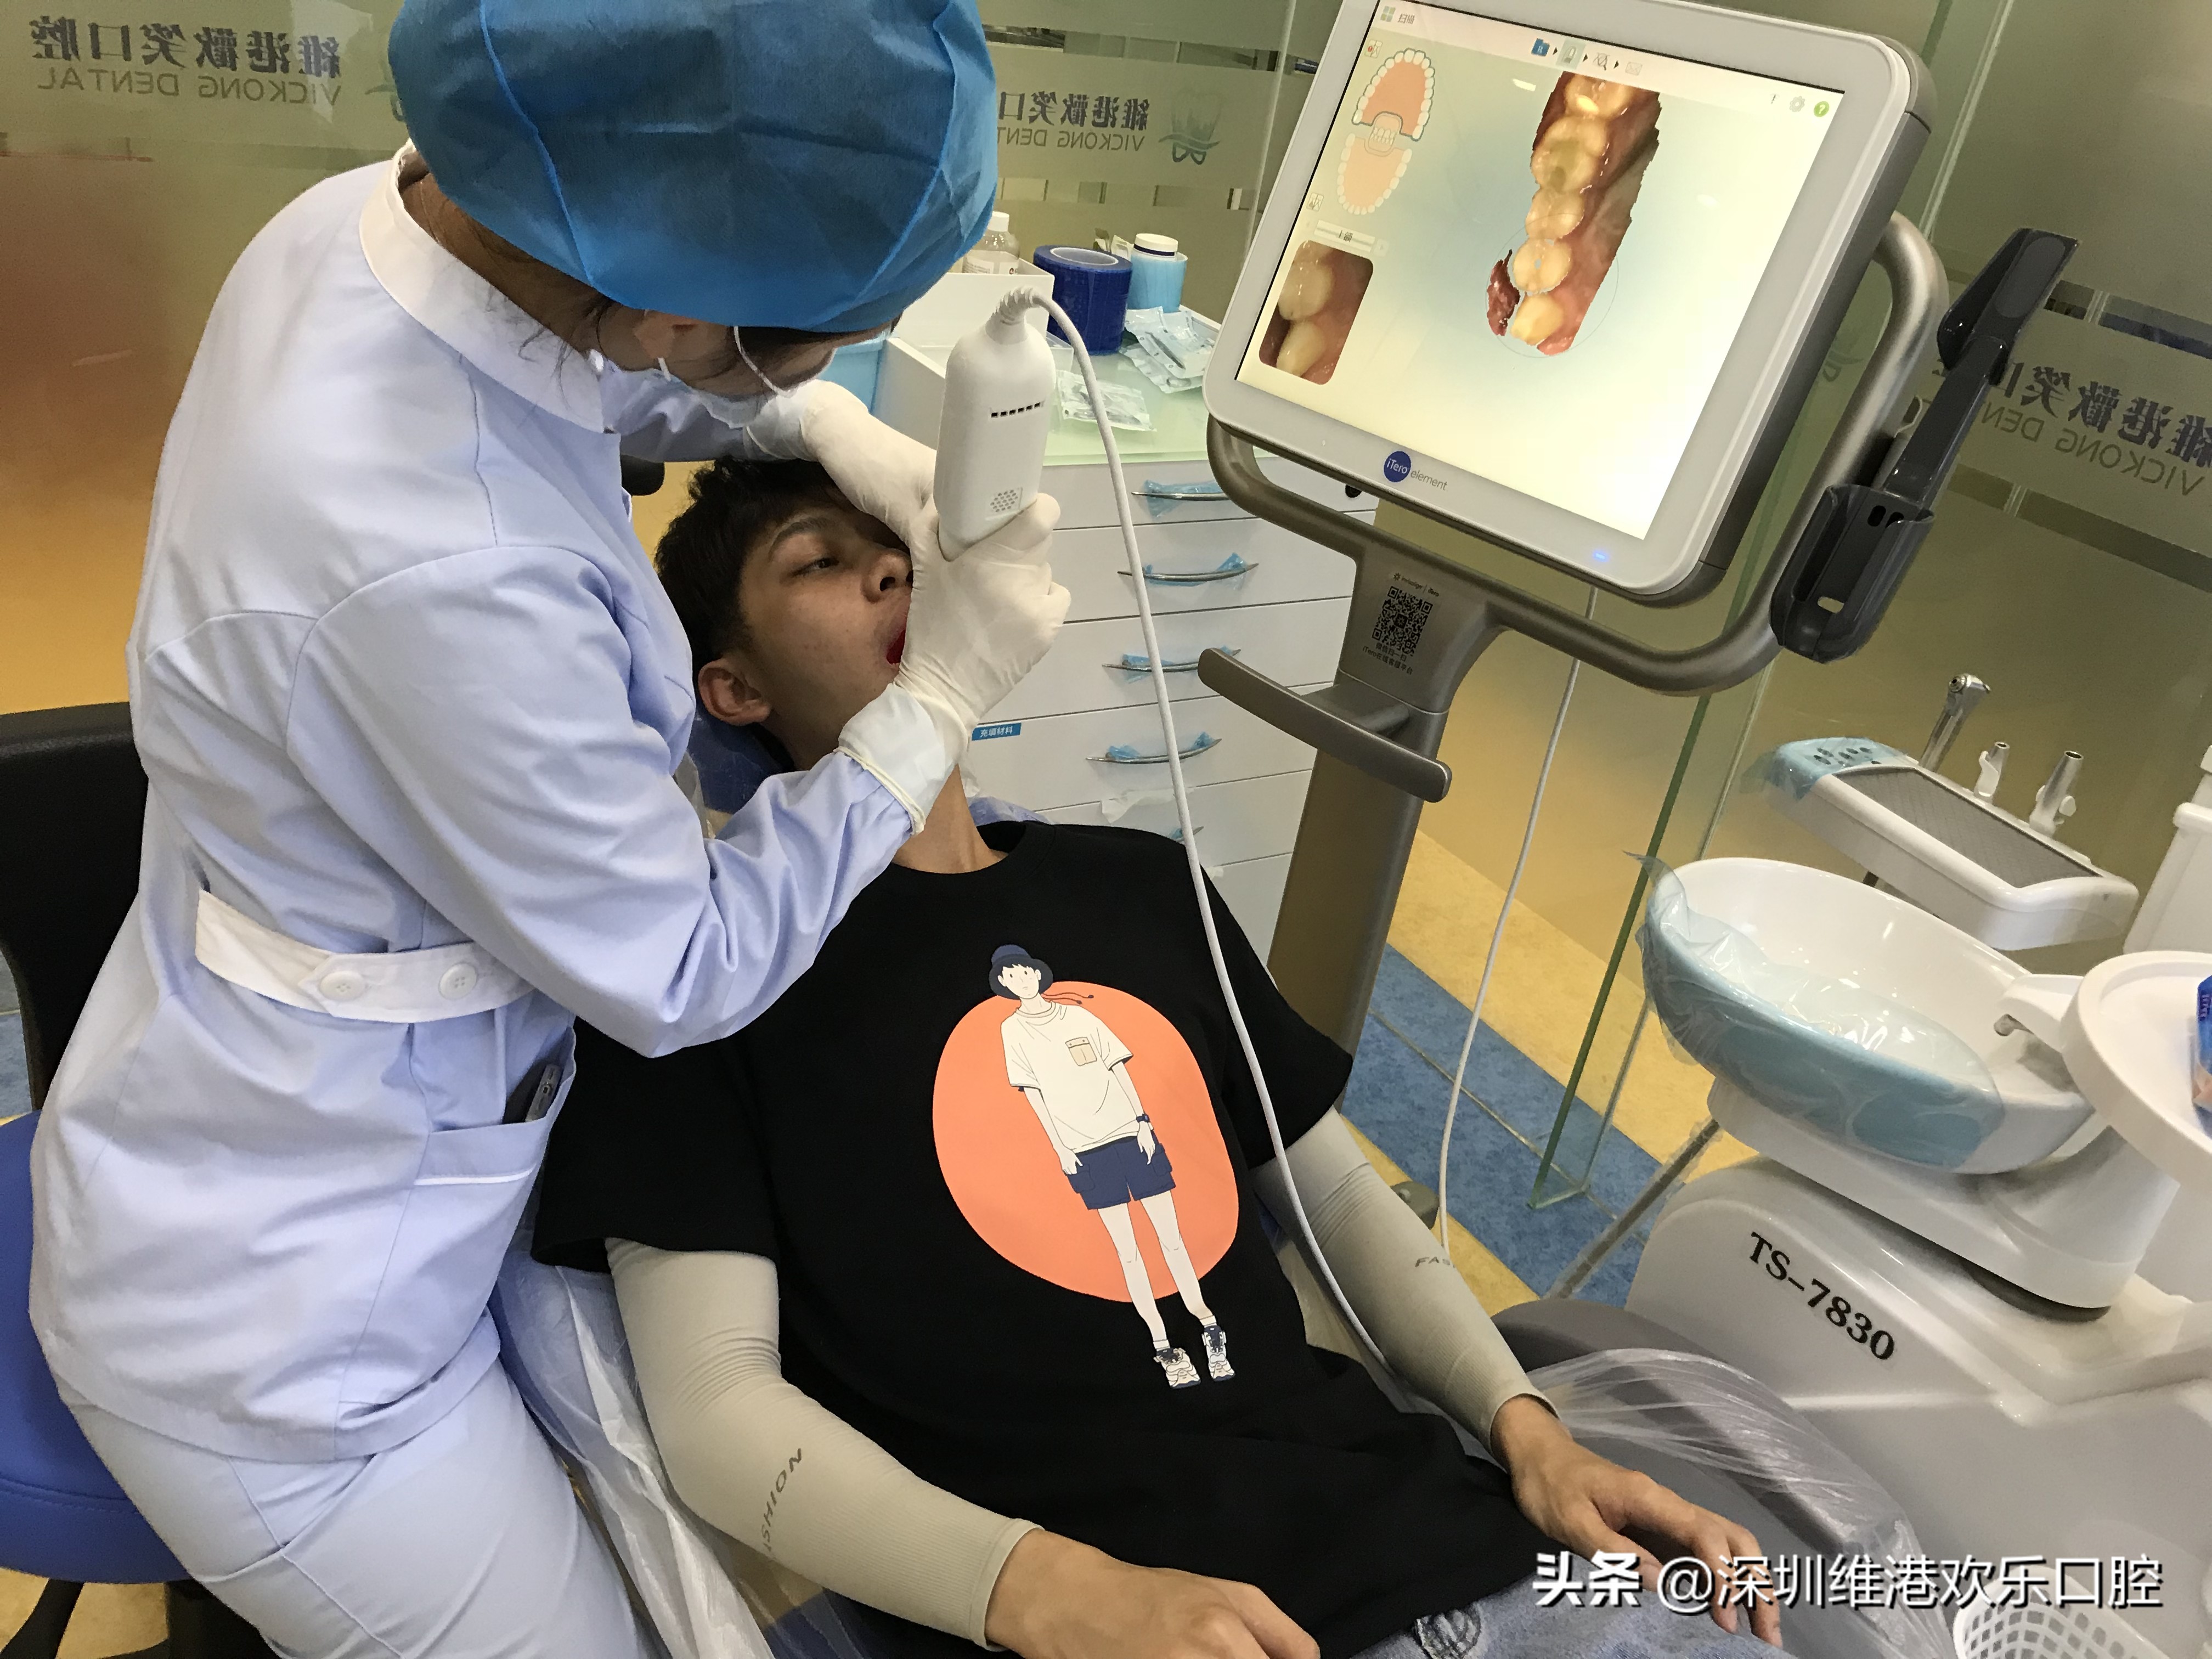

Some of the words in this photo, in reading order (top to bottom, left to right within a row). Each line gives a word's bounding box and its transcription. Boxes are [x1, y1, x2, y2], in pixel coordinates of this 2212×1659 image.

[1386, 457, 1408, 476] iTero
[1410, 467, 1448, 492] element
[980, 725, 1013, 737] 充填材料
[1748, 1231, 1895, 1361] TS-7830
